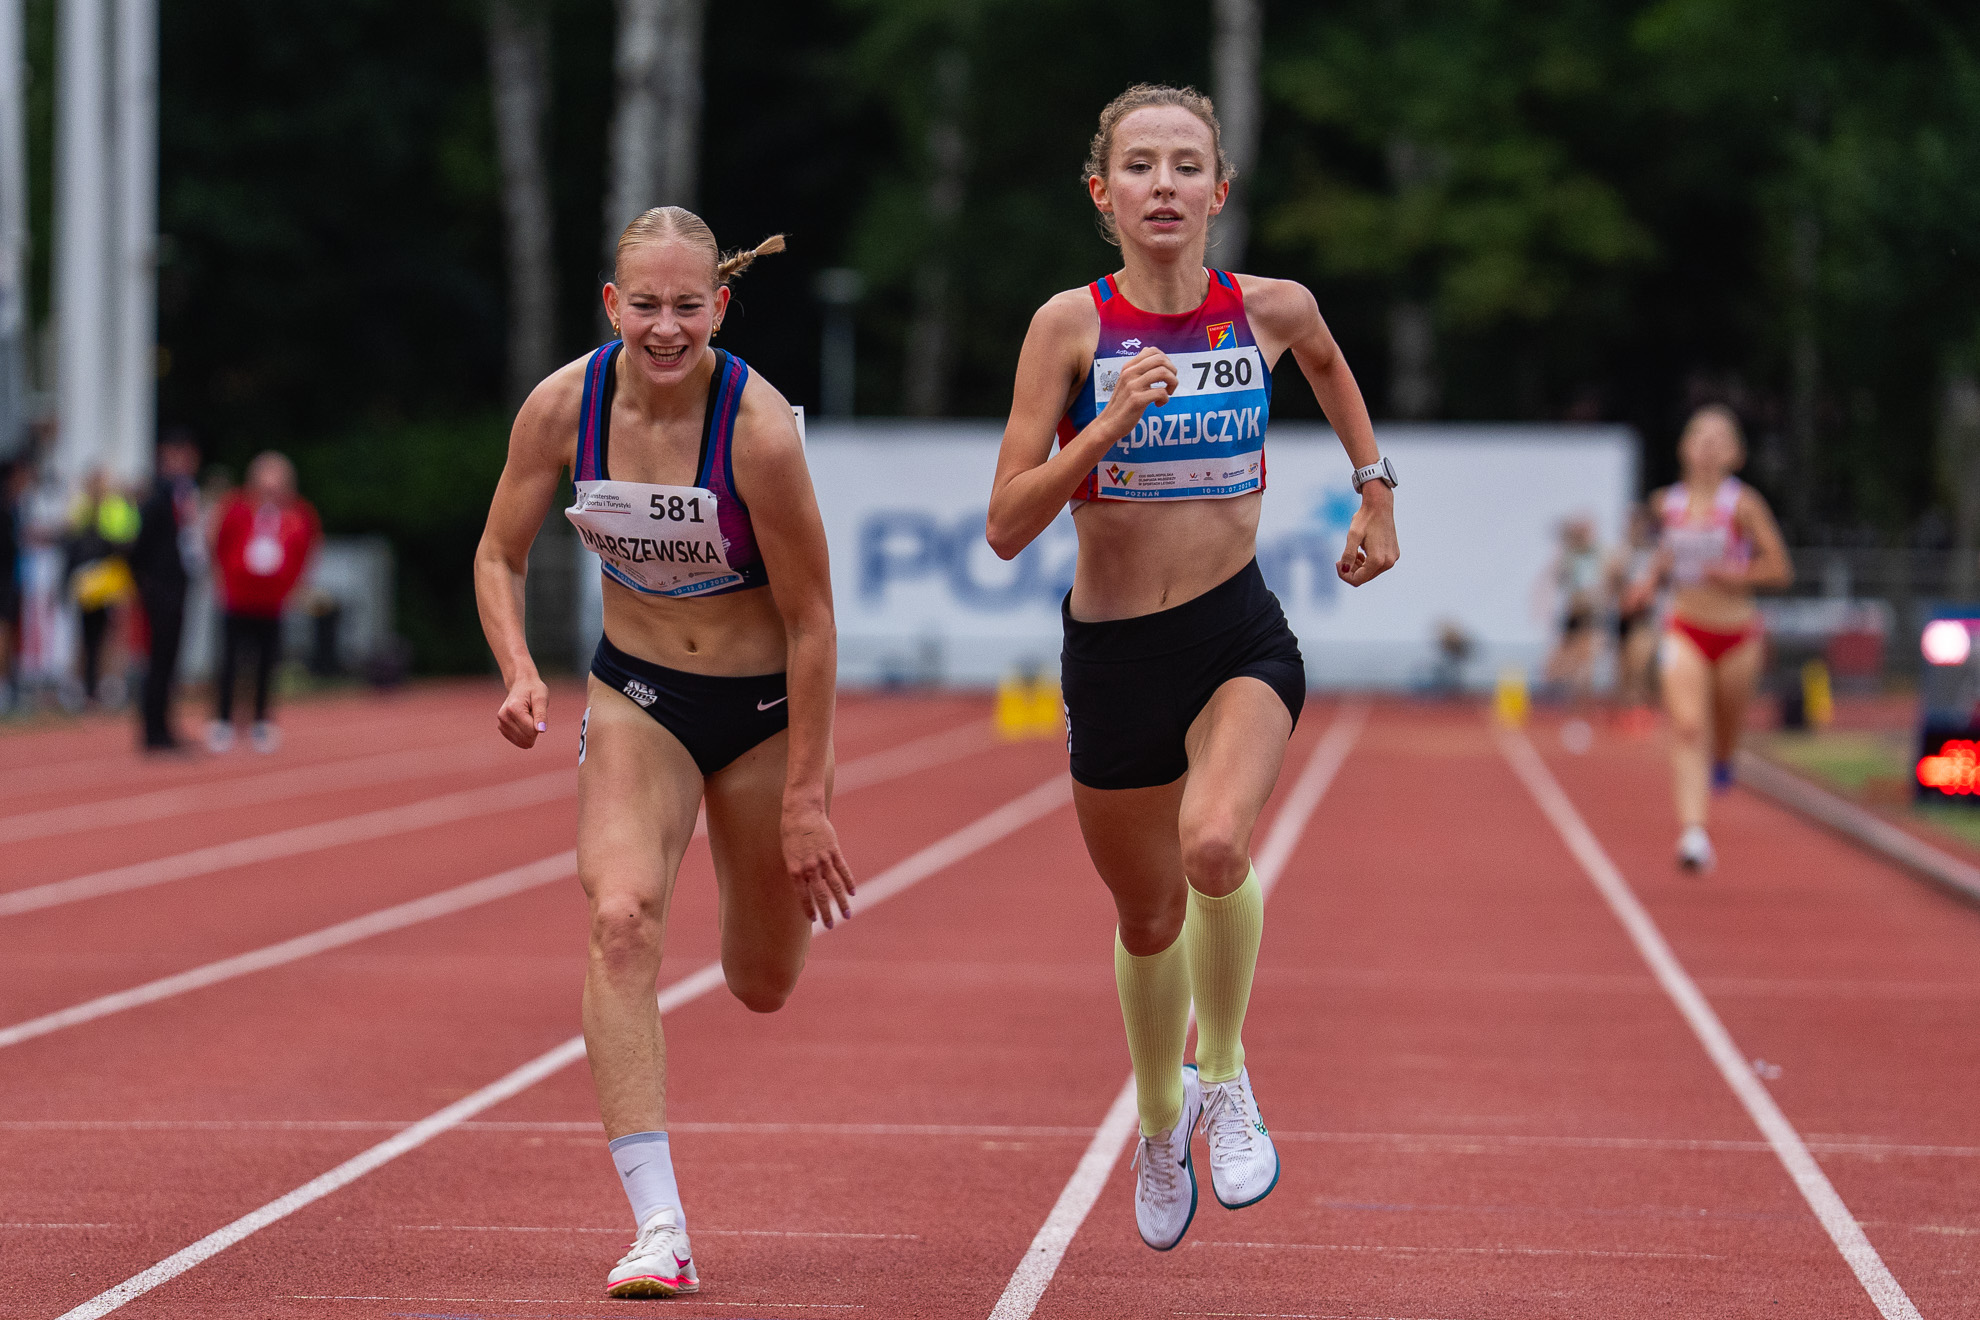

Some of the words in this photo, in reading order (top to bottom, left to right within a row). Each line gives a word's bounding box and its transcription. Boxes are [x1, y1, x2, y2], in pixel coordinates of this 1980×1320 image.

[1192, 358, 1252, 390] 780
[606, 500, 632, 510] Turystyki
[649, 493, 704, 523] 581
[1125, 489, 1160, 497] POZNAŃ
[577, 524, 722, 564] MARSZEWSKA
